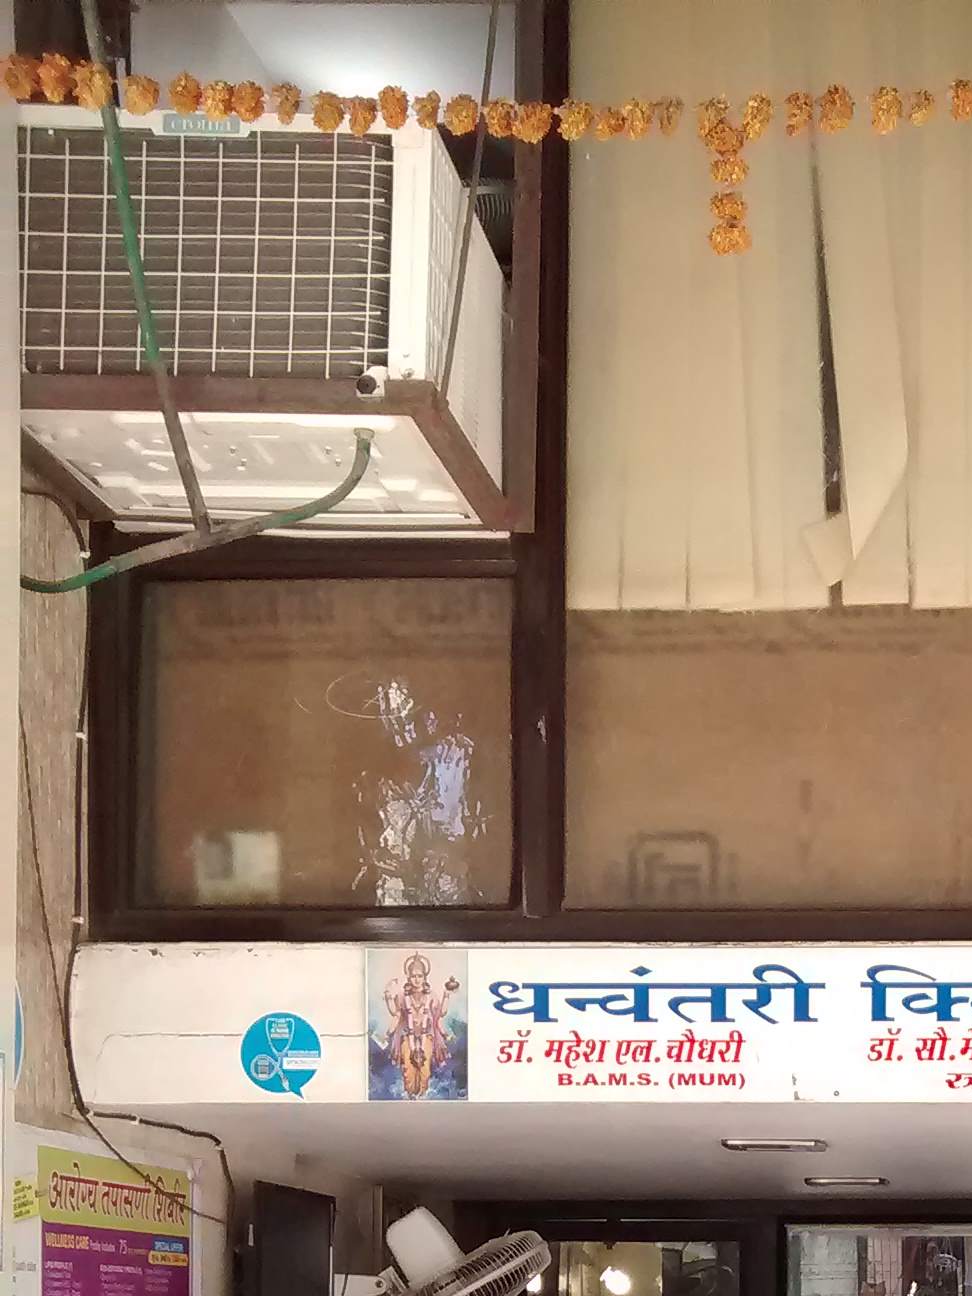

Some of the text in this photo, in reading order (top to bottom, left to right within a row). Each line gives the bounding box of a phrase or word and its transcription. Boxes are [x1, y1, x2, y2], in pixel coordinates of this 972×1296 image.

[488, 964, 826, 1024] धन्वंतरी
[496, 1029, 533, 1064] डॉ.
[544, 1030, 609, 1069] महेश
[867, 1027, 904, 1062] डॉ.
[557, 1072, 746, 1090] B.A.M.S. (MUM)
[49, 1161, 100, 1214] आरोग्य
